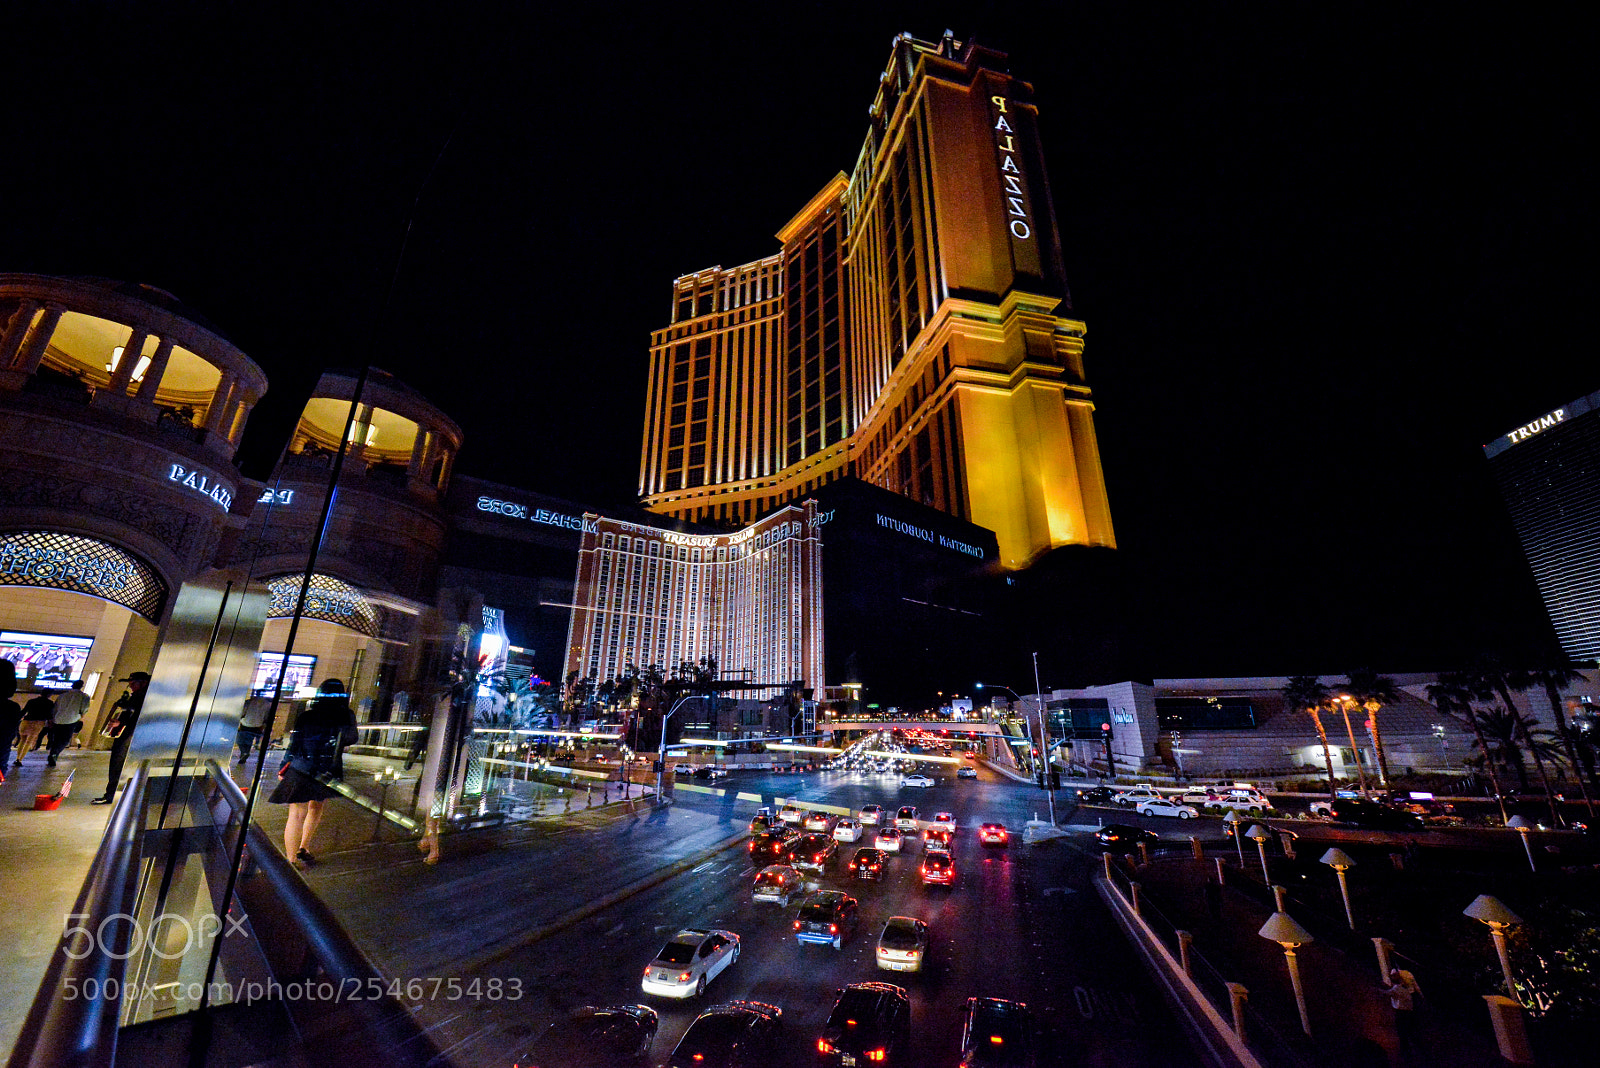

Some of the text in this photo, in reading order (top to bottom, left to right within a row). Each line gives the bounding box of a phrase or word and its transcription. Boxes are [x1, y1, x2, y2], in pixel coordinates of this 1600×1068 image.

[1507, 409, 1564, 443] TRUMP
[663, 532, 718, 547] TREASURE
[0, 543, 138, 576] RAND CANAL
